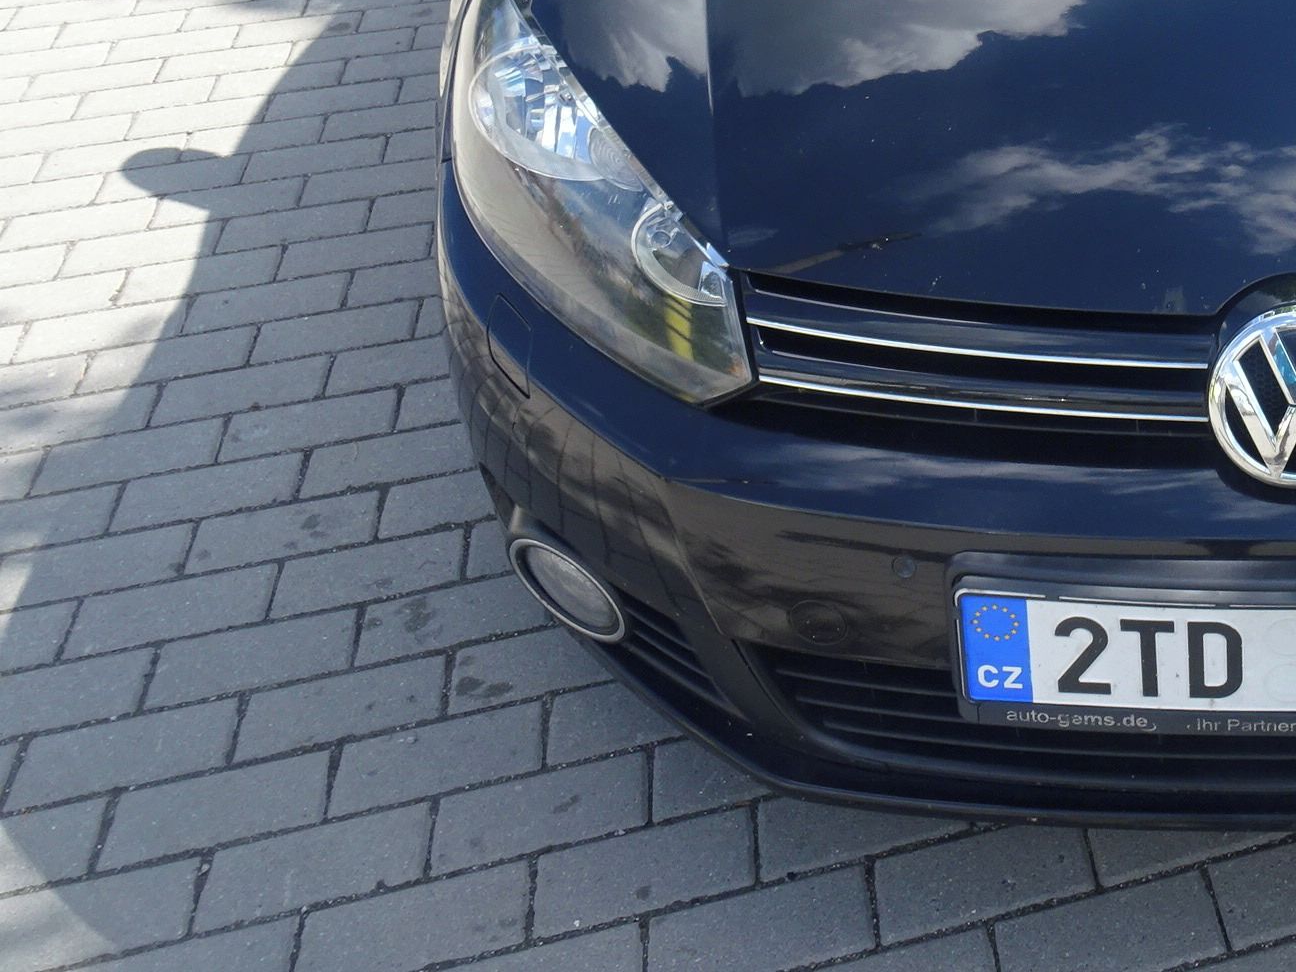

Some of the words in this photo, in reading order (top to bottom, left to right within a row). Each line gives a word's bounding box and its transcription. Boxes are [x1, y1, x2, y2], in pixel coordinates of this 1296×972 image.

[1053, 617, 1244, 699] 2TD
[976, 664, 1024, 690] CZ
[1227, 718, 1296, 732] Partner
